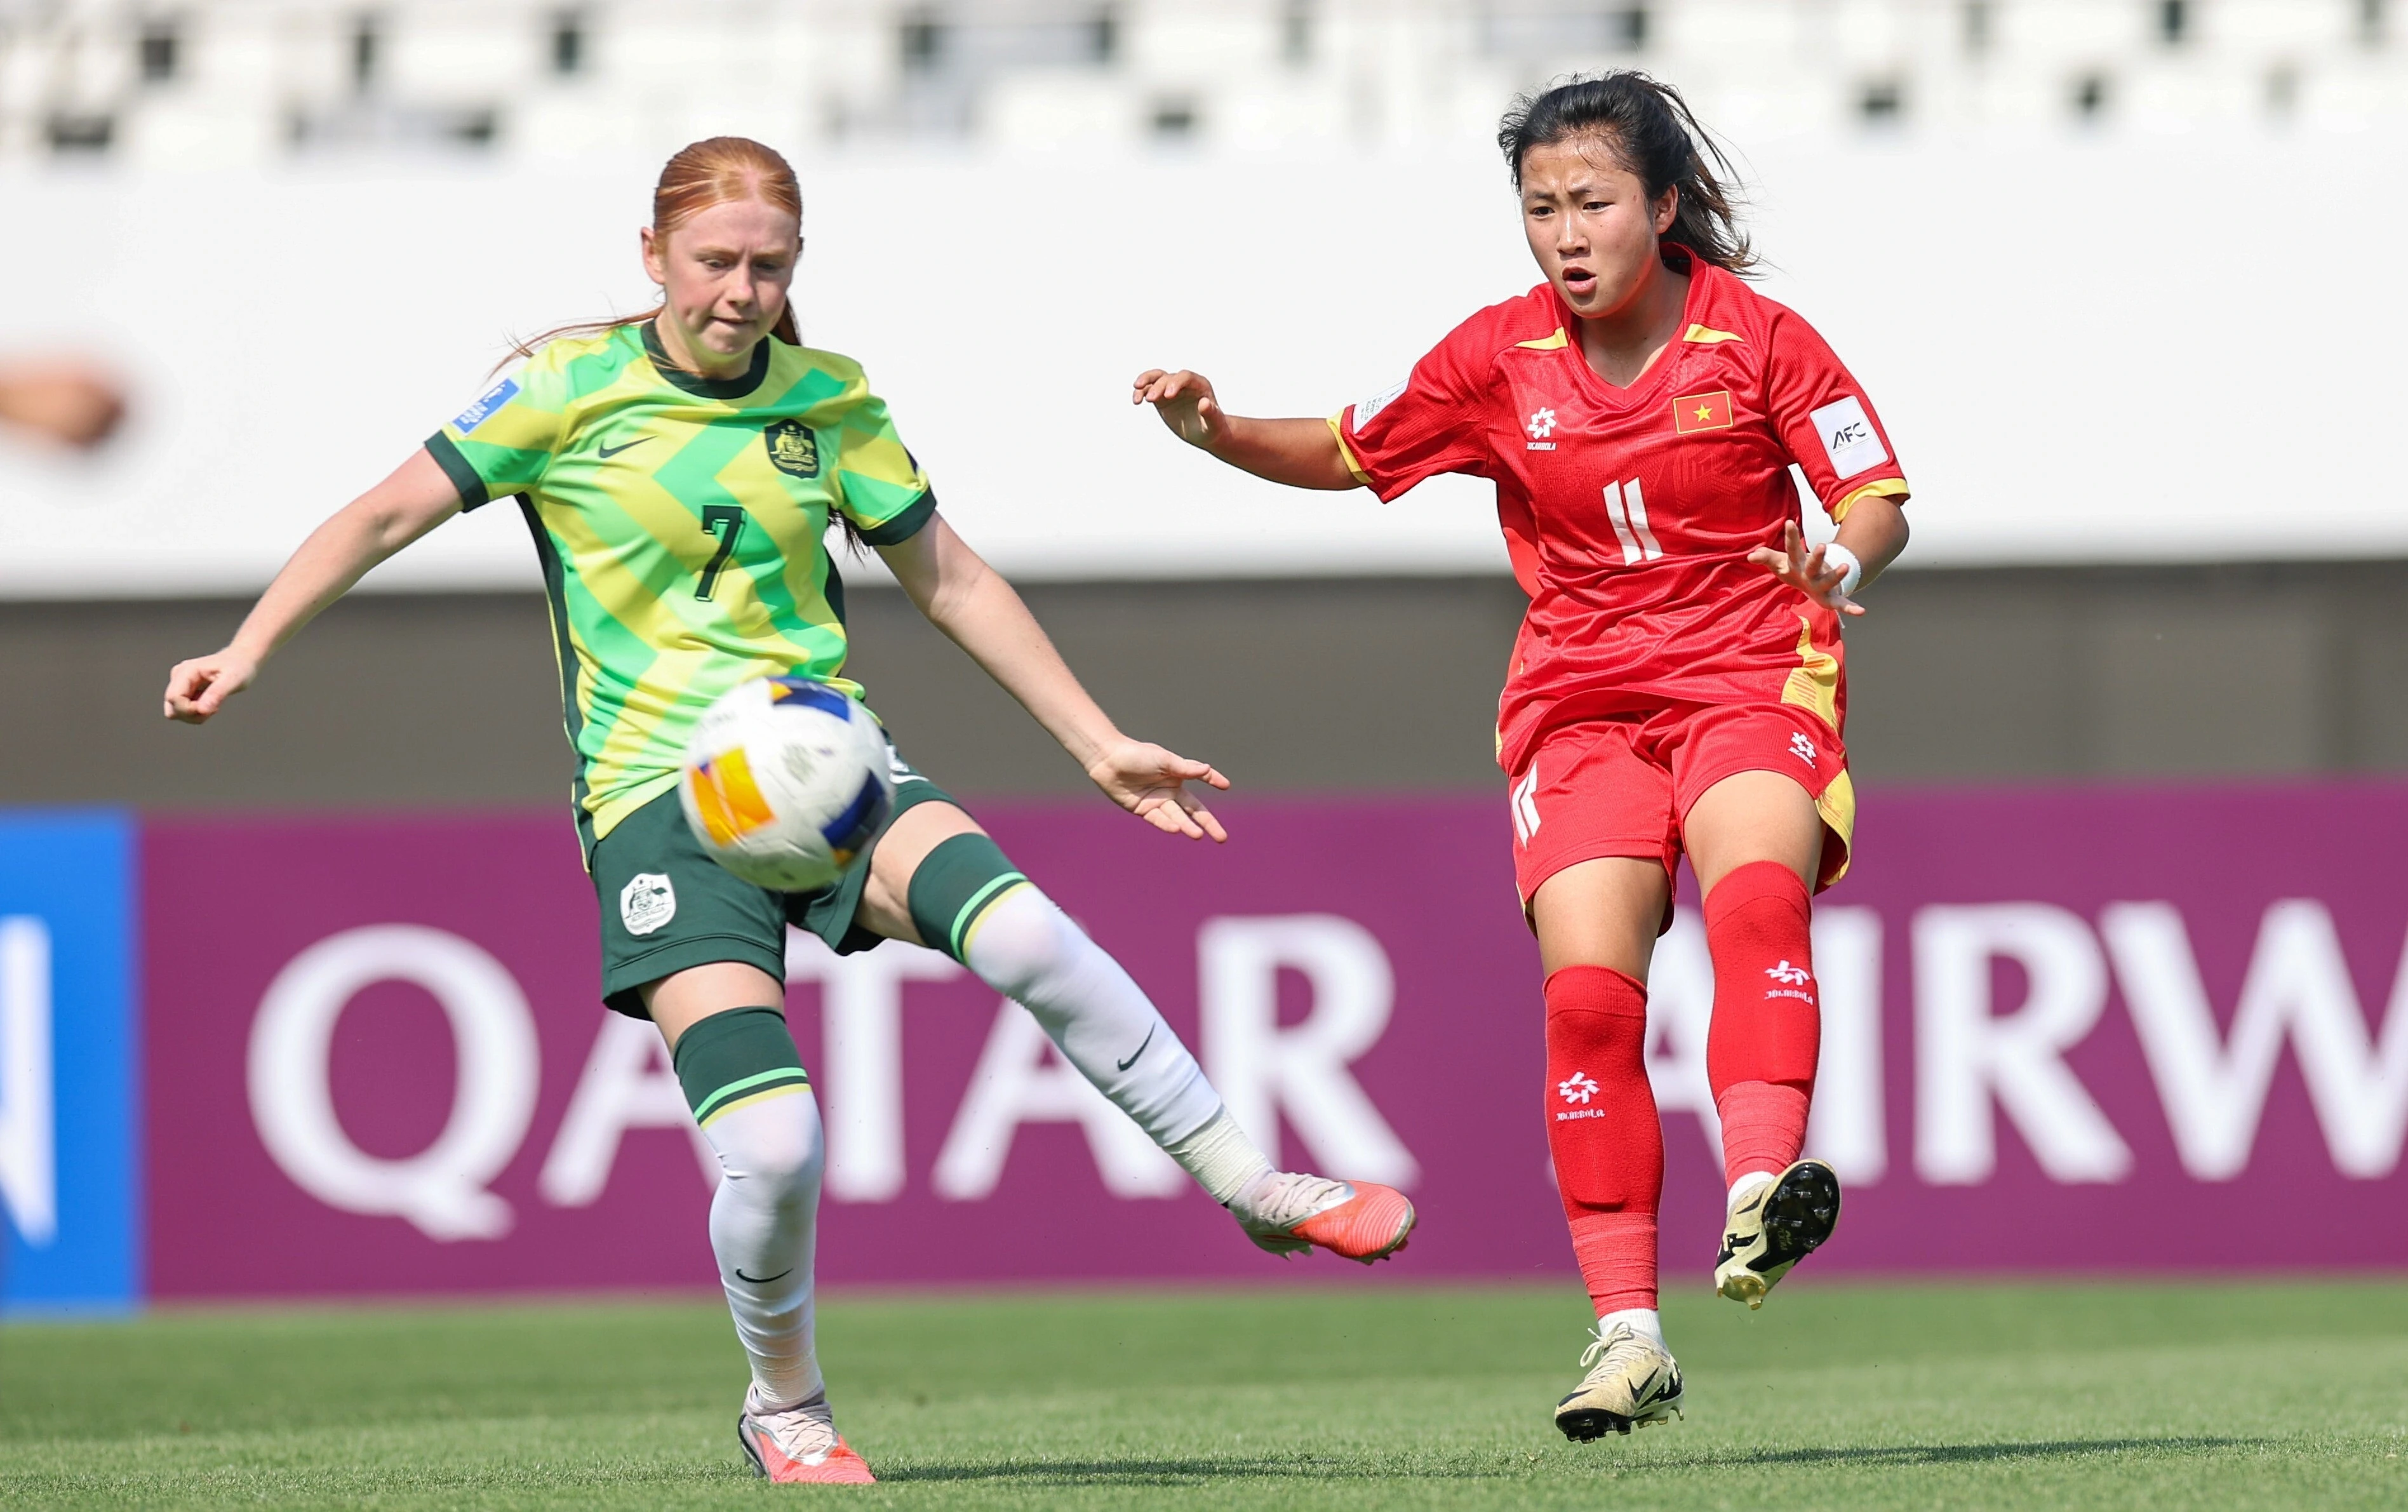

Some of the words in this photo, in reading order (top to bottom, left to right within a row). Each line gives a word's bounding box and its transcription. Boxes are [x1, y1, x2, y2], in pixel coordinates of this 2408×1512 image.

[1833, 421, 1866, 450] AFC
[695, 504, 747, 602] 7
[1602, 476, 1664, 567] 11
